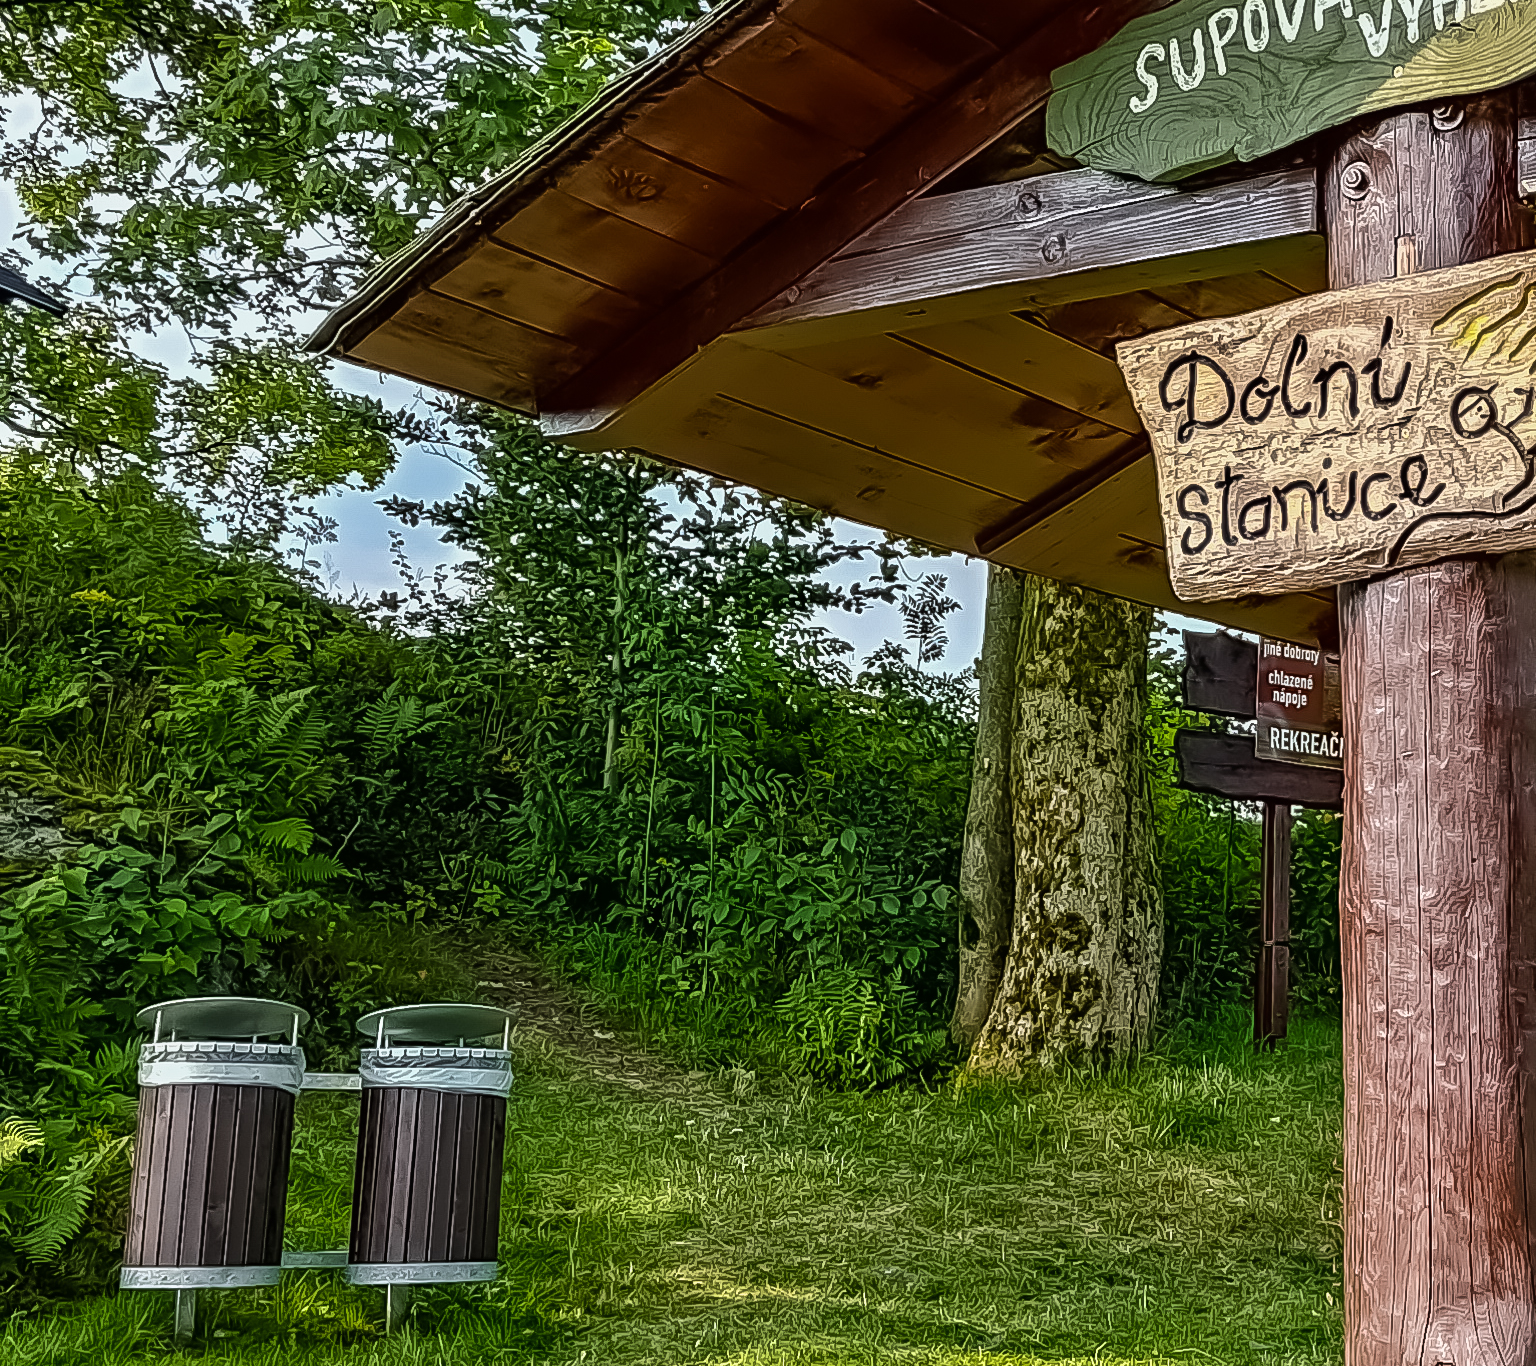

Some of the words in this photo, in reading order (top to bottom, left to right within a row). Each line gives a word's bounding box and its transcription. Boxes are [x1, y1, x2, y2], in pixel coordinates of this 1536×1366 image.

[1158, 315, 1412, 444] Dolní
[1284, 643, 1319, 665] dobroty
[1268, 670, 1314, 690] chlazené
[1272, 688, 1308, 708] nápoje
